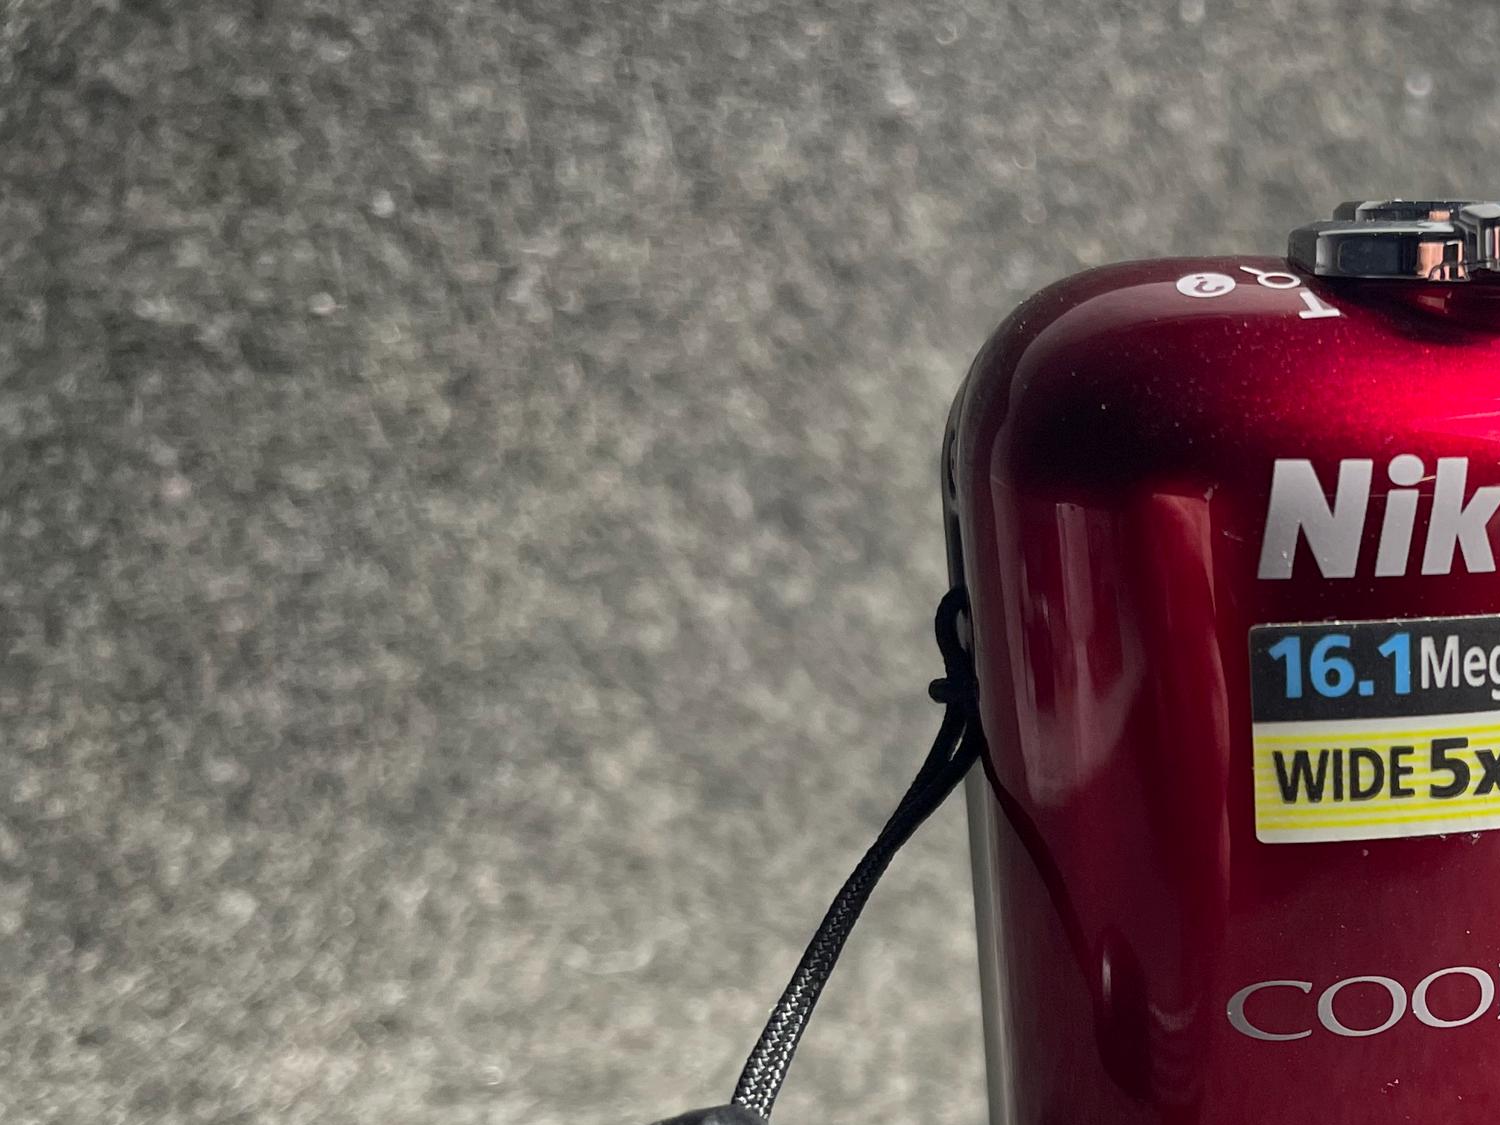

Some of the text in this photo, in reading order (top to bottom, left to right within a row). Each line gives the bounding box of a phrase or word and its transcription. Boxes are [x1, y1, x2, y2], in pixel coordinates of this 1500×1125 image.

[1299, 287, 1341, 319] T
[1268, 631, 1411, 699] 16.1
[1272, 746, 1415, 804] WIDE
